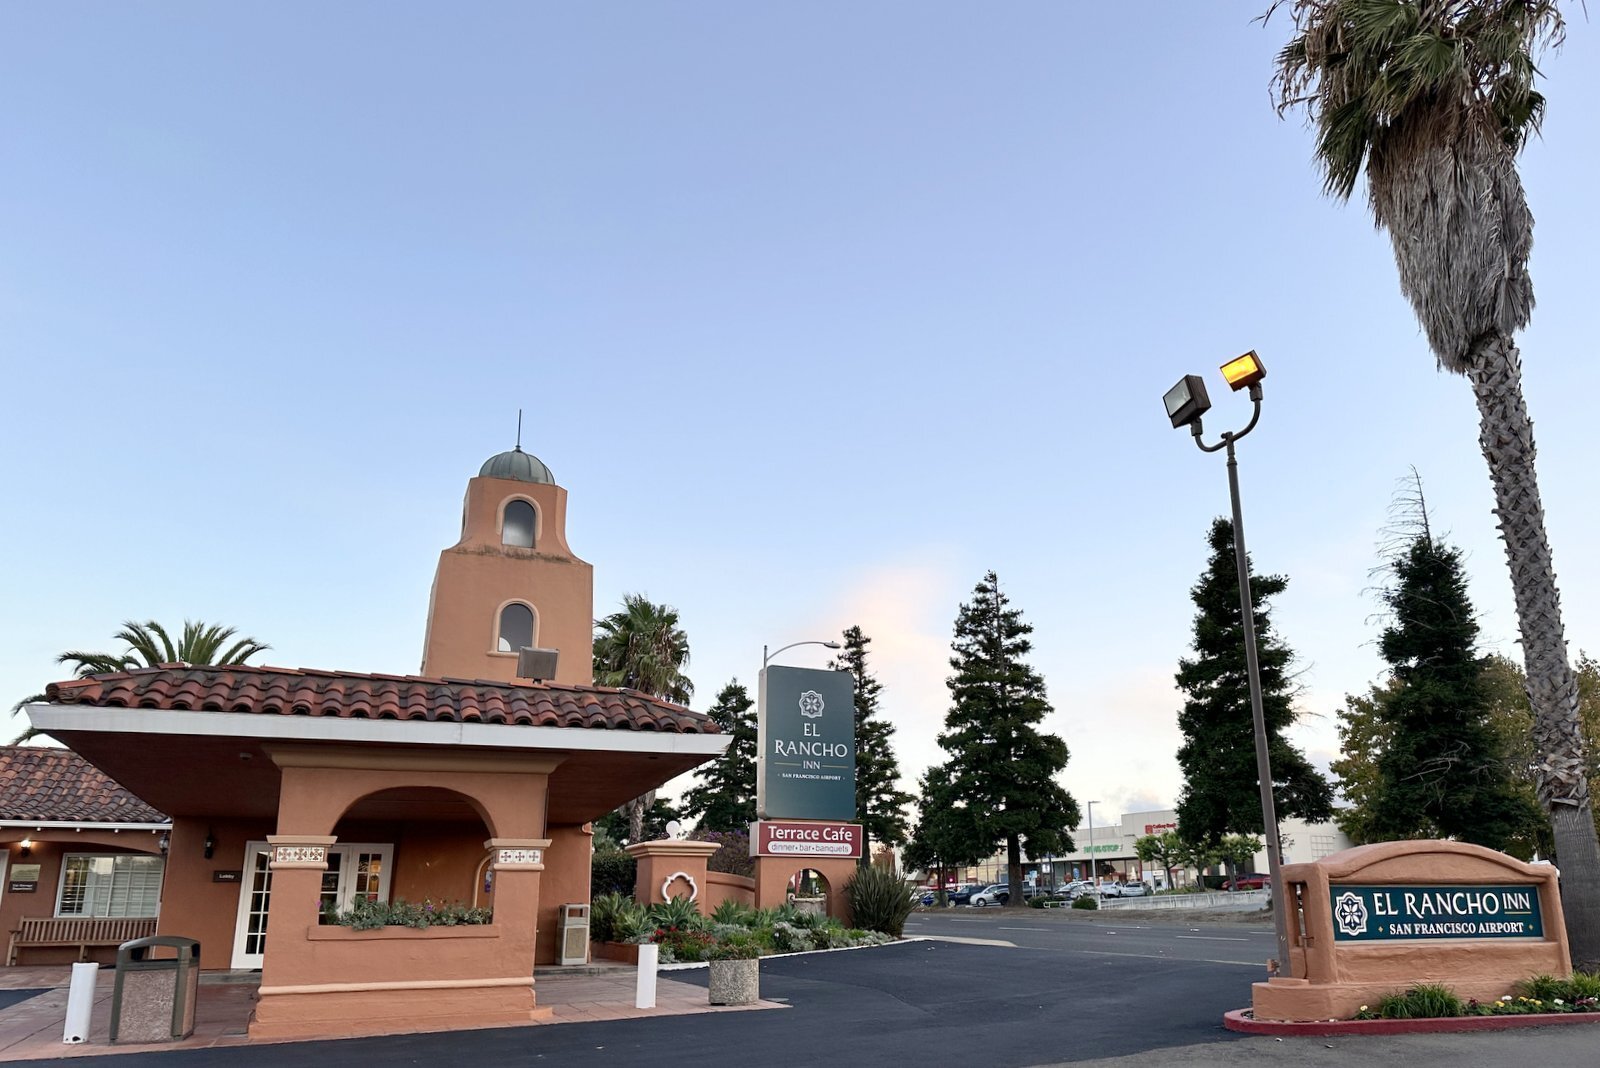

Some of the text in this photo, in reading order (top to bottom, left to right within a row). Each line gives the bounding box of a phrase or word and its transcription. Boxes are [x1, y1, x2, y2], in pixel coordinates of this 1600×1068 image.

[803, 723, 821, 737] EL
[774, 739, 848, 757] RANCHO
[803, 760, 821, 769] INN
[768, 826, 852, 841] Terrace Cafe
[771, 843, 849, 853] dinner bar banquets
[1373, 892, 1531, 919] EL RANCHO INN
[1389, 922, 1524, 935] SAN FRANCISCO AIRPORT
